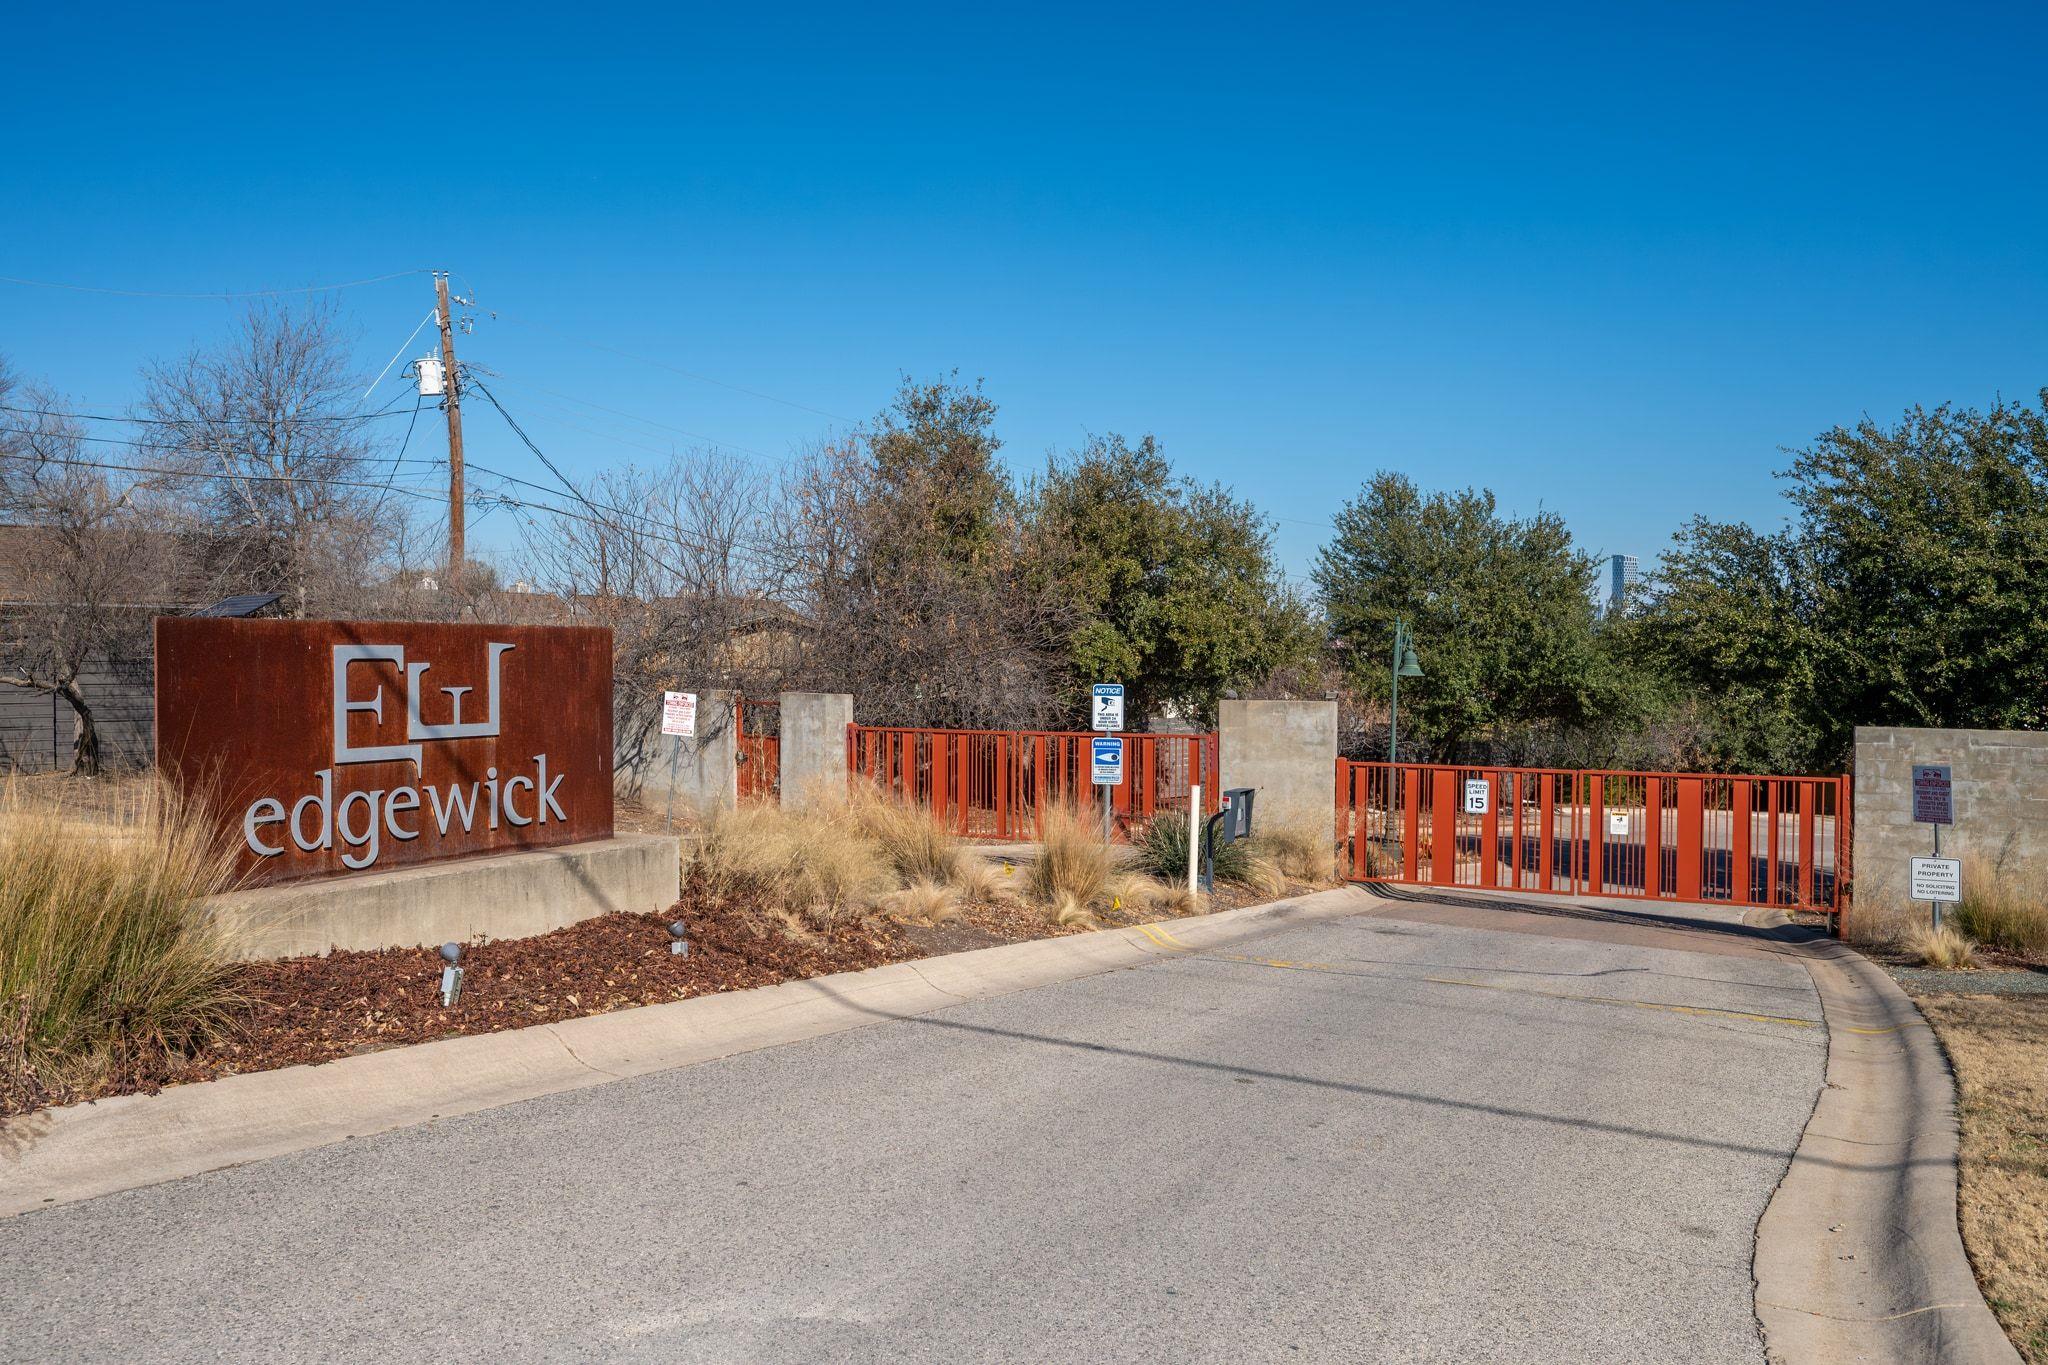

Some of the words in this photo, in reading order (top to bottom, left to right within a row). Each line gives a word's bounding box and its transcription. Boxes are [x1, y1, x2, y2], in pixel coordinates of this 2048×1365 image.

[1470, 797, 1484, 809] 15
[243, 754, 567, 869] edgewick
[1917, 870, 1954, 878] PROPERTY
